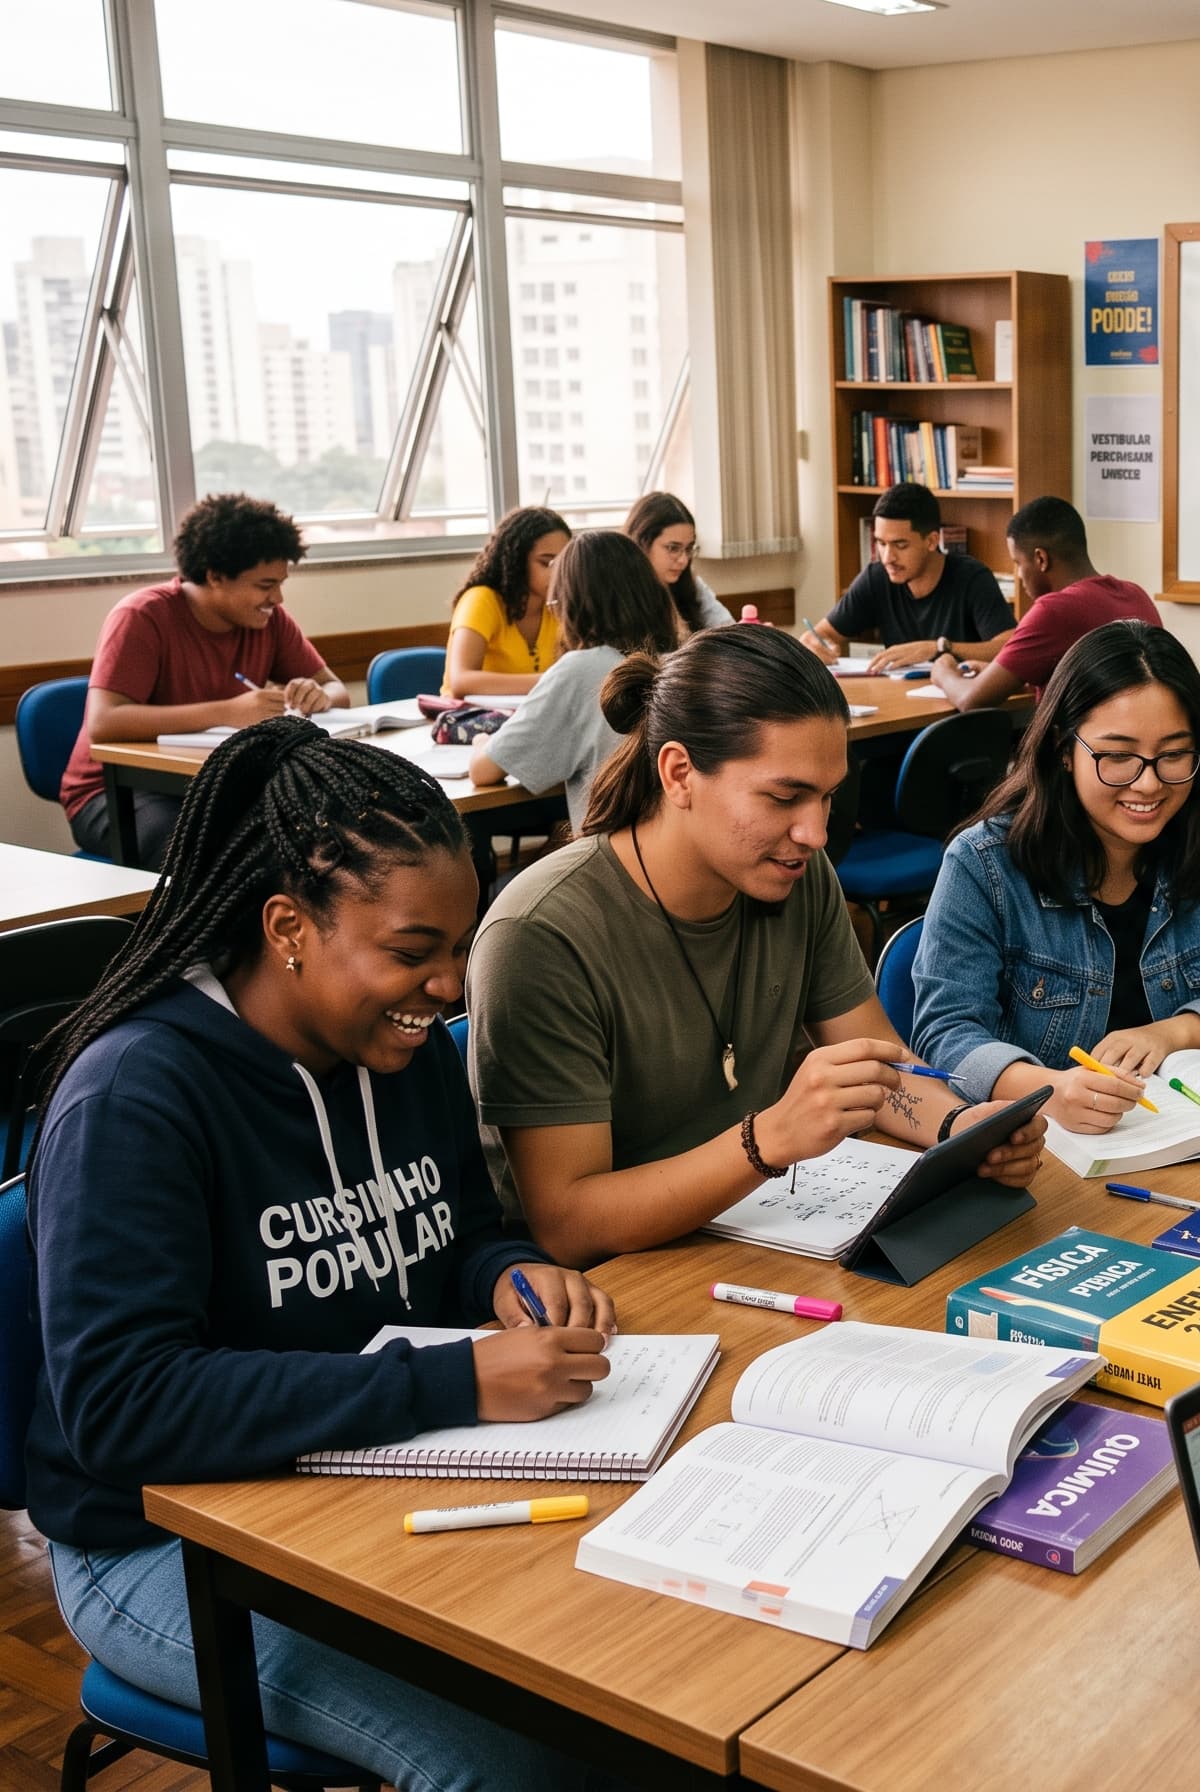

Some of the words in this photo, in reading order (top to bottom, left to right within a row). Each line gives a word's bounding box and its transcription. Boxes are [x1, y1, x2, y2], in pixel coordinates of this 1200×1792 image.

[1091, 307, 1152, 333] PODDE!
[1091, 433, 1151, 445] VESTIBULAR
[259, 1155, 441, 1249] CURSINHO
[266, 1201, 454, 1309] POPULAR
[1010, 1243, 1109, 1289] FÍSICA
[1026, 1433, 1141, 1518] QUÍMICA
